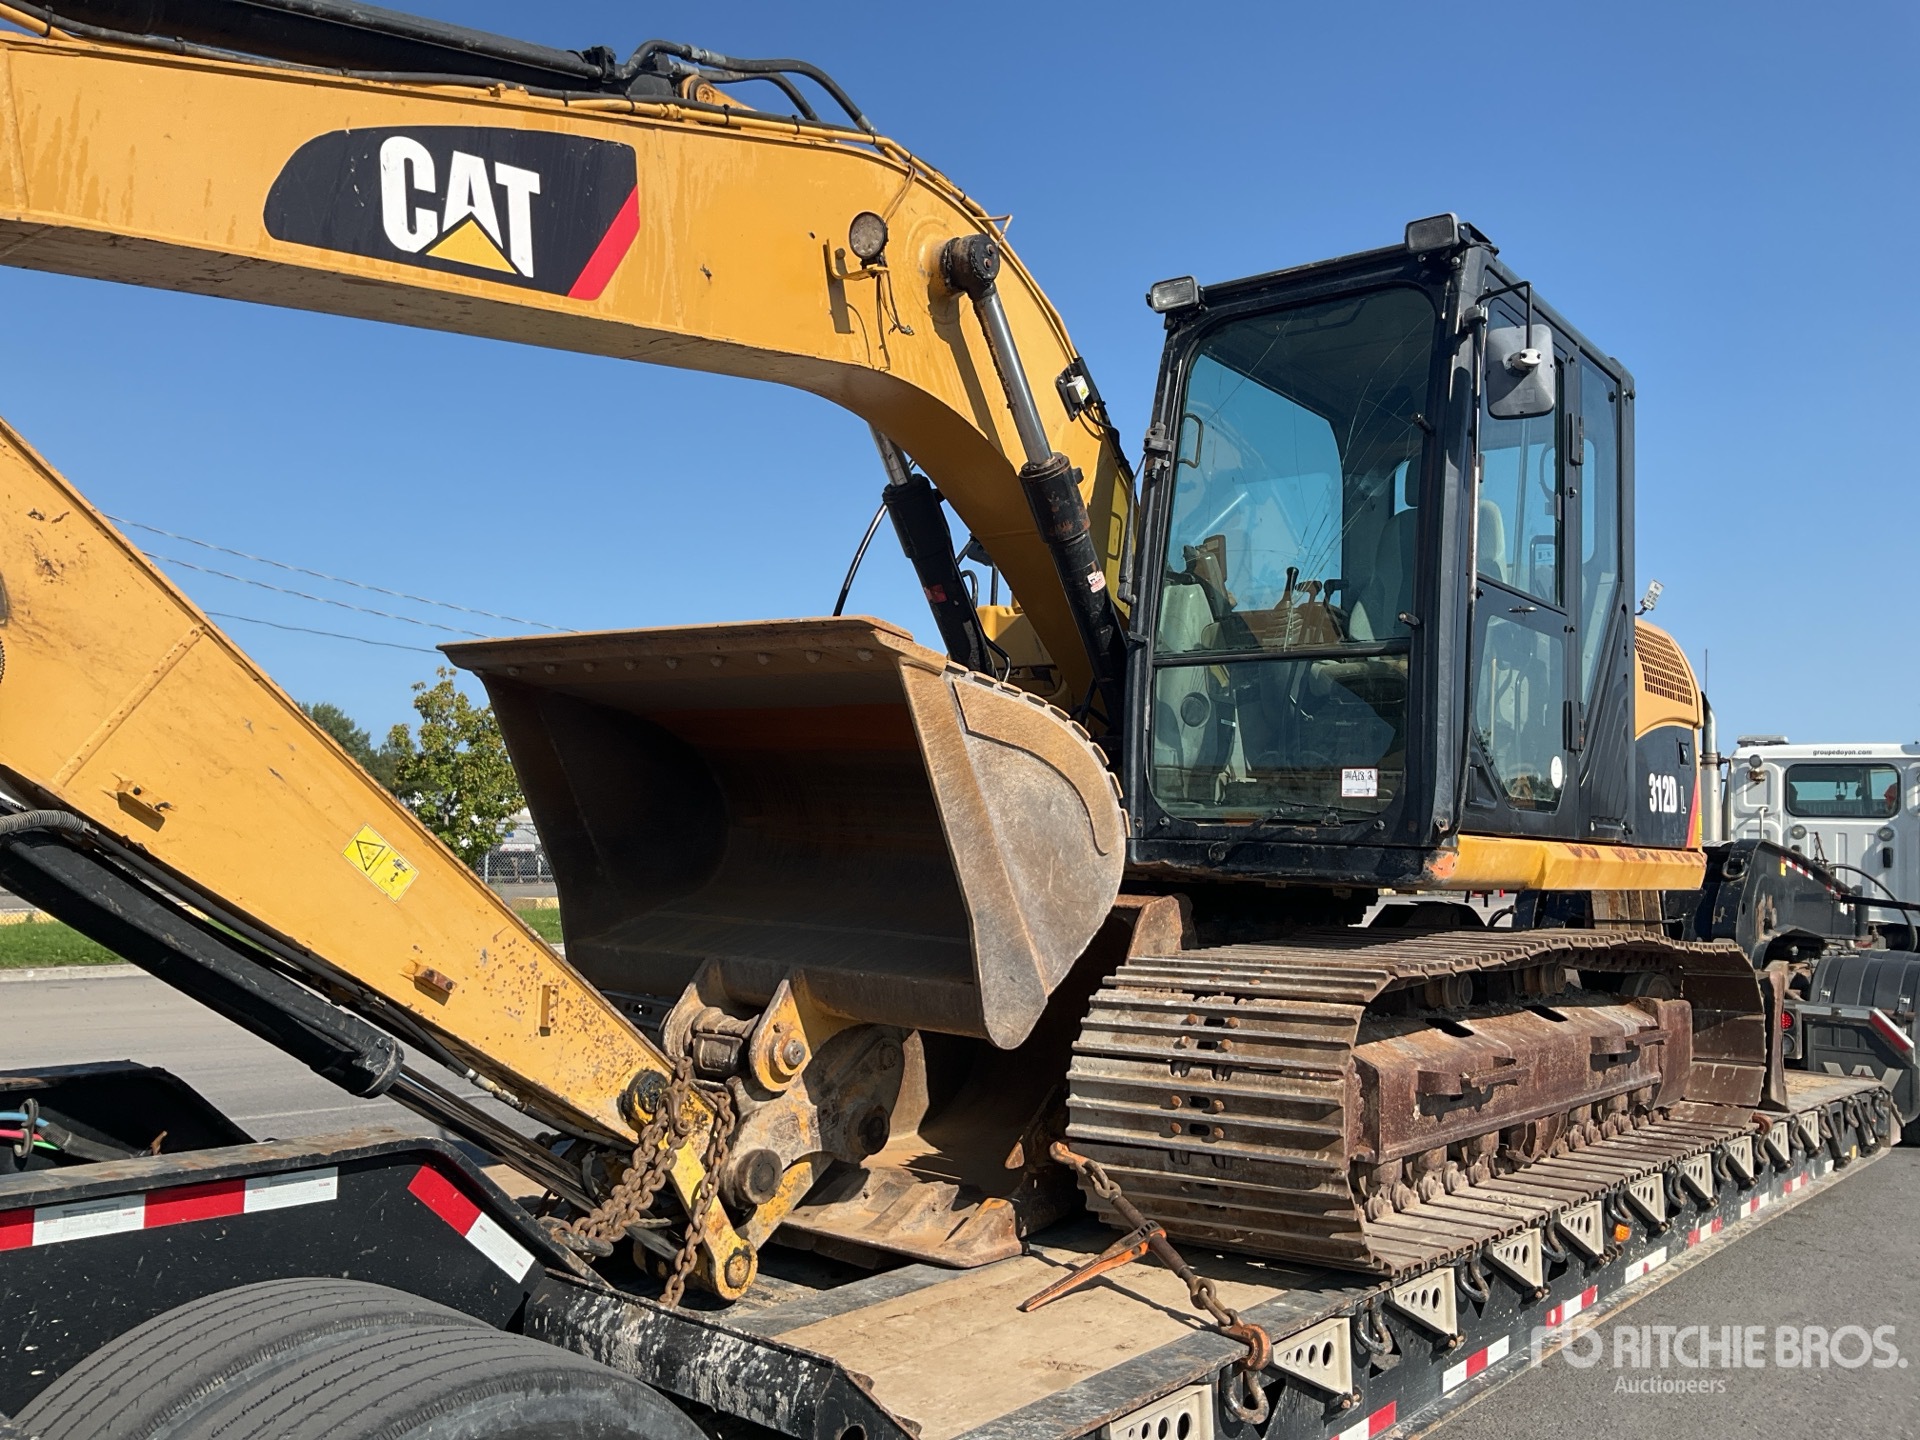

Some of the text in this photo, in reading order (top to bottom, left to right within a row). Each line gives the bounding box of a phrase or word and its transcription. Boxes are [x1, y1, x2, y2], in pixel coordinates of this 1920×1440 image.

[380, 136, 541, 278] CAT
[1812, 749, 1873, 757] groupedoyon.com
[1648, 773, 1678, 813] 312D
